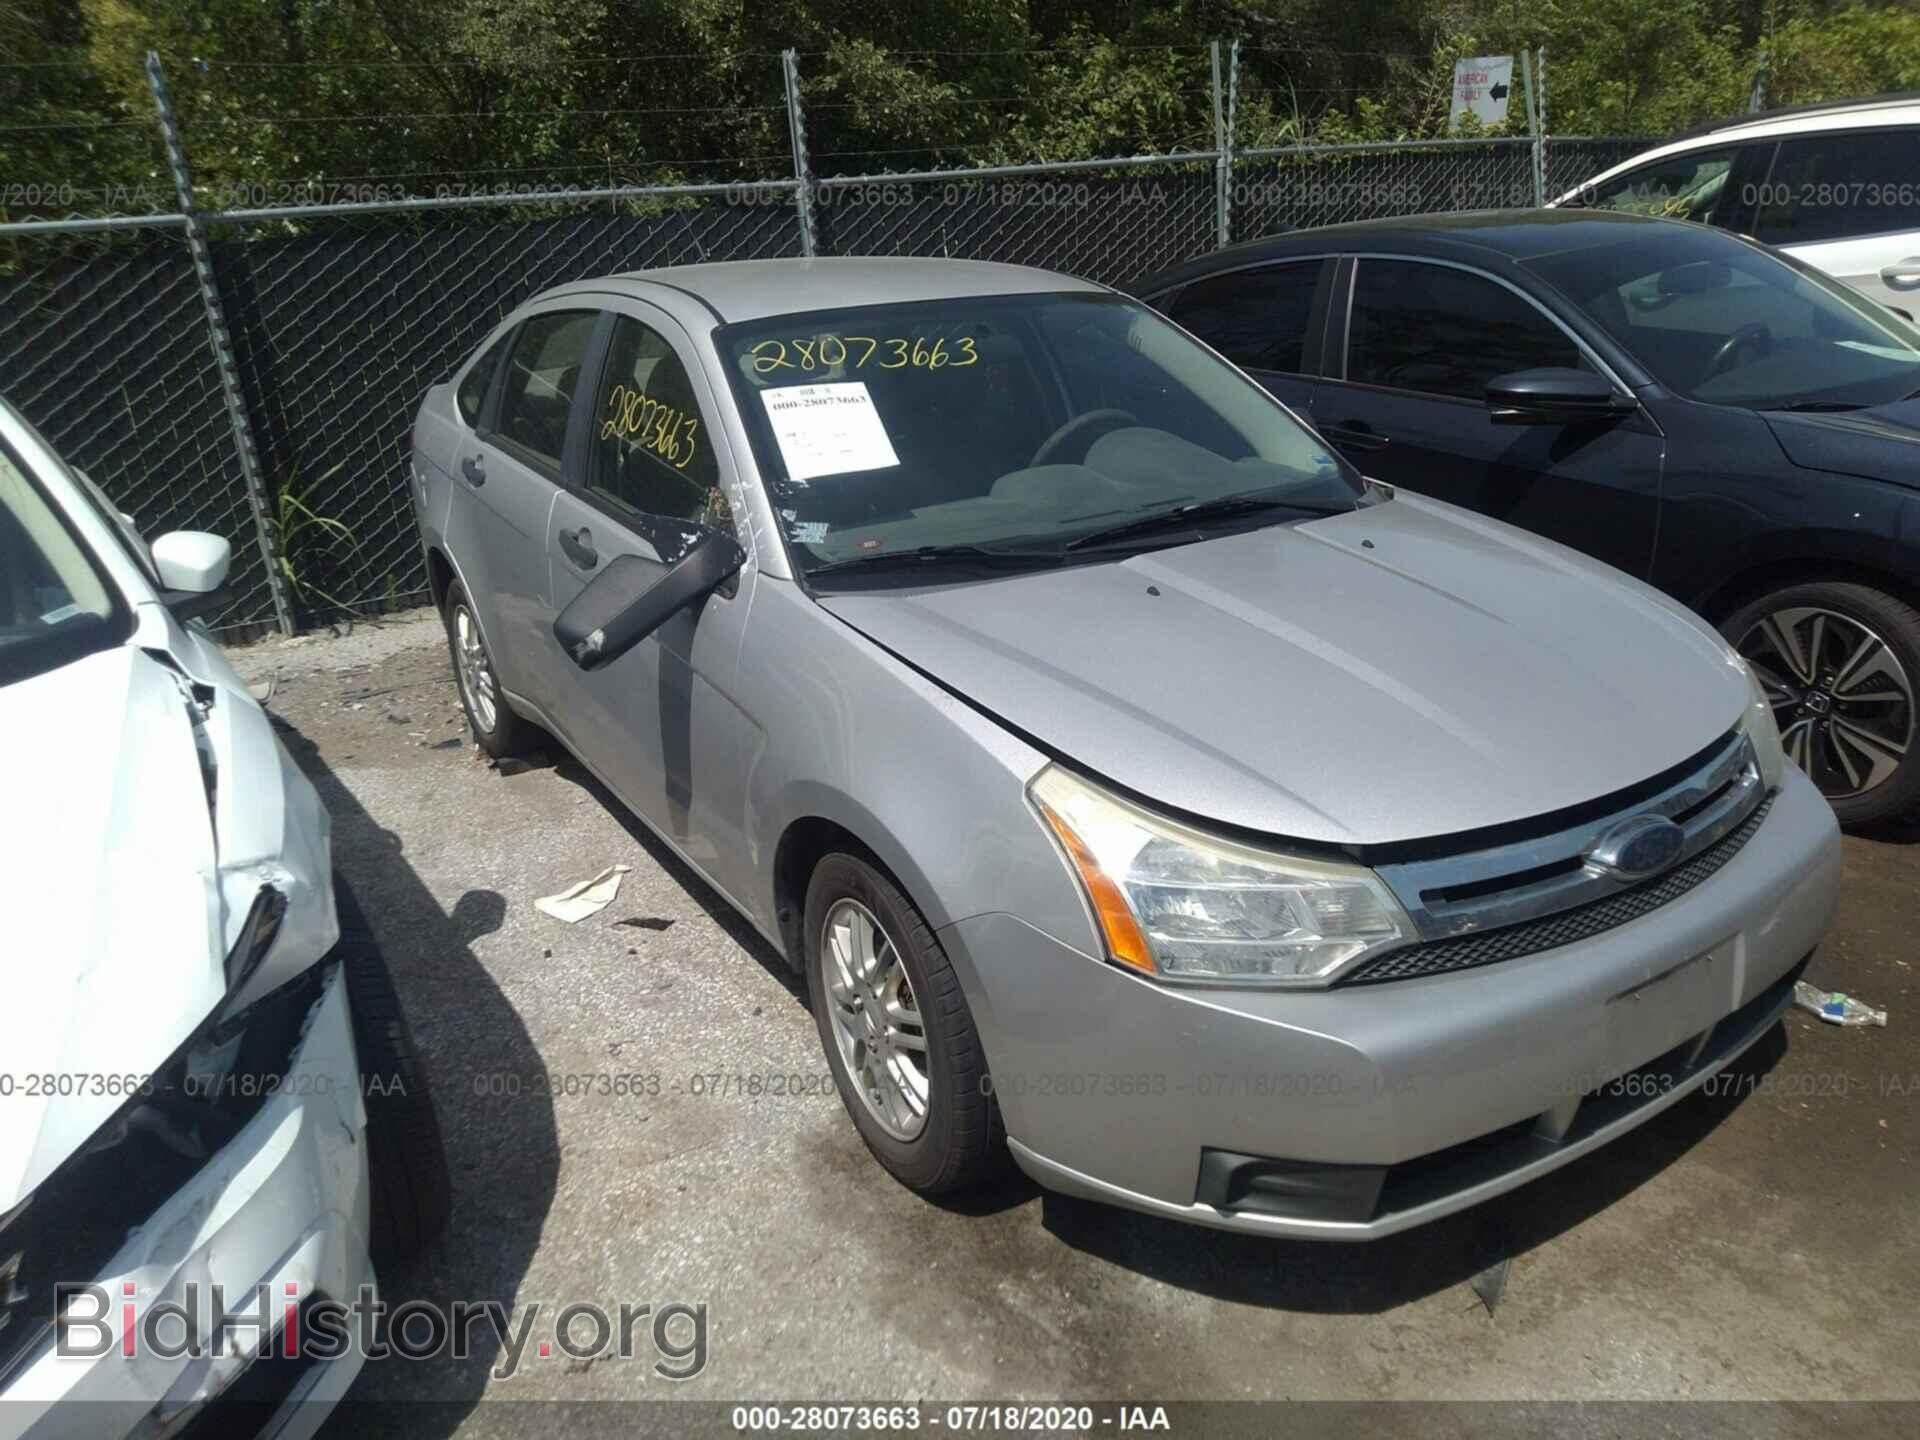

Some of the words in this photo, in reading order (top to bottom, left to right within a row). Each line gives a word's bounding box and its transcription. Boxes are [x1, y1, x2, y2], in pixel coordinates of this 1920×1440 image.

[751, 335, 978, 373] 28073663
[772, 394, 867, 411] 000-28073663
[601, 384, 698, 468] 28073663
